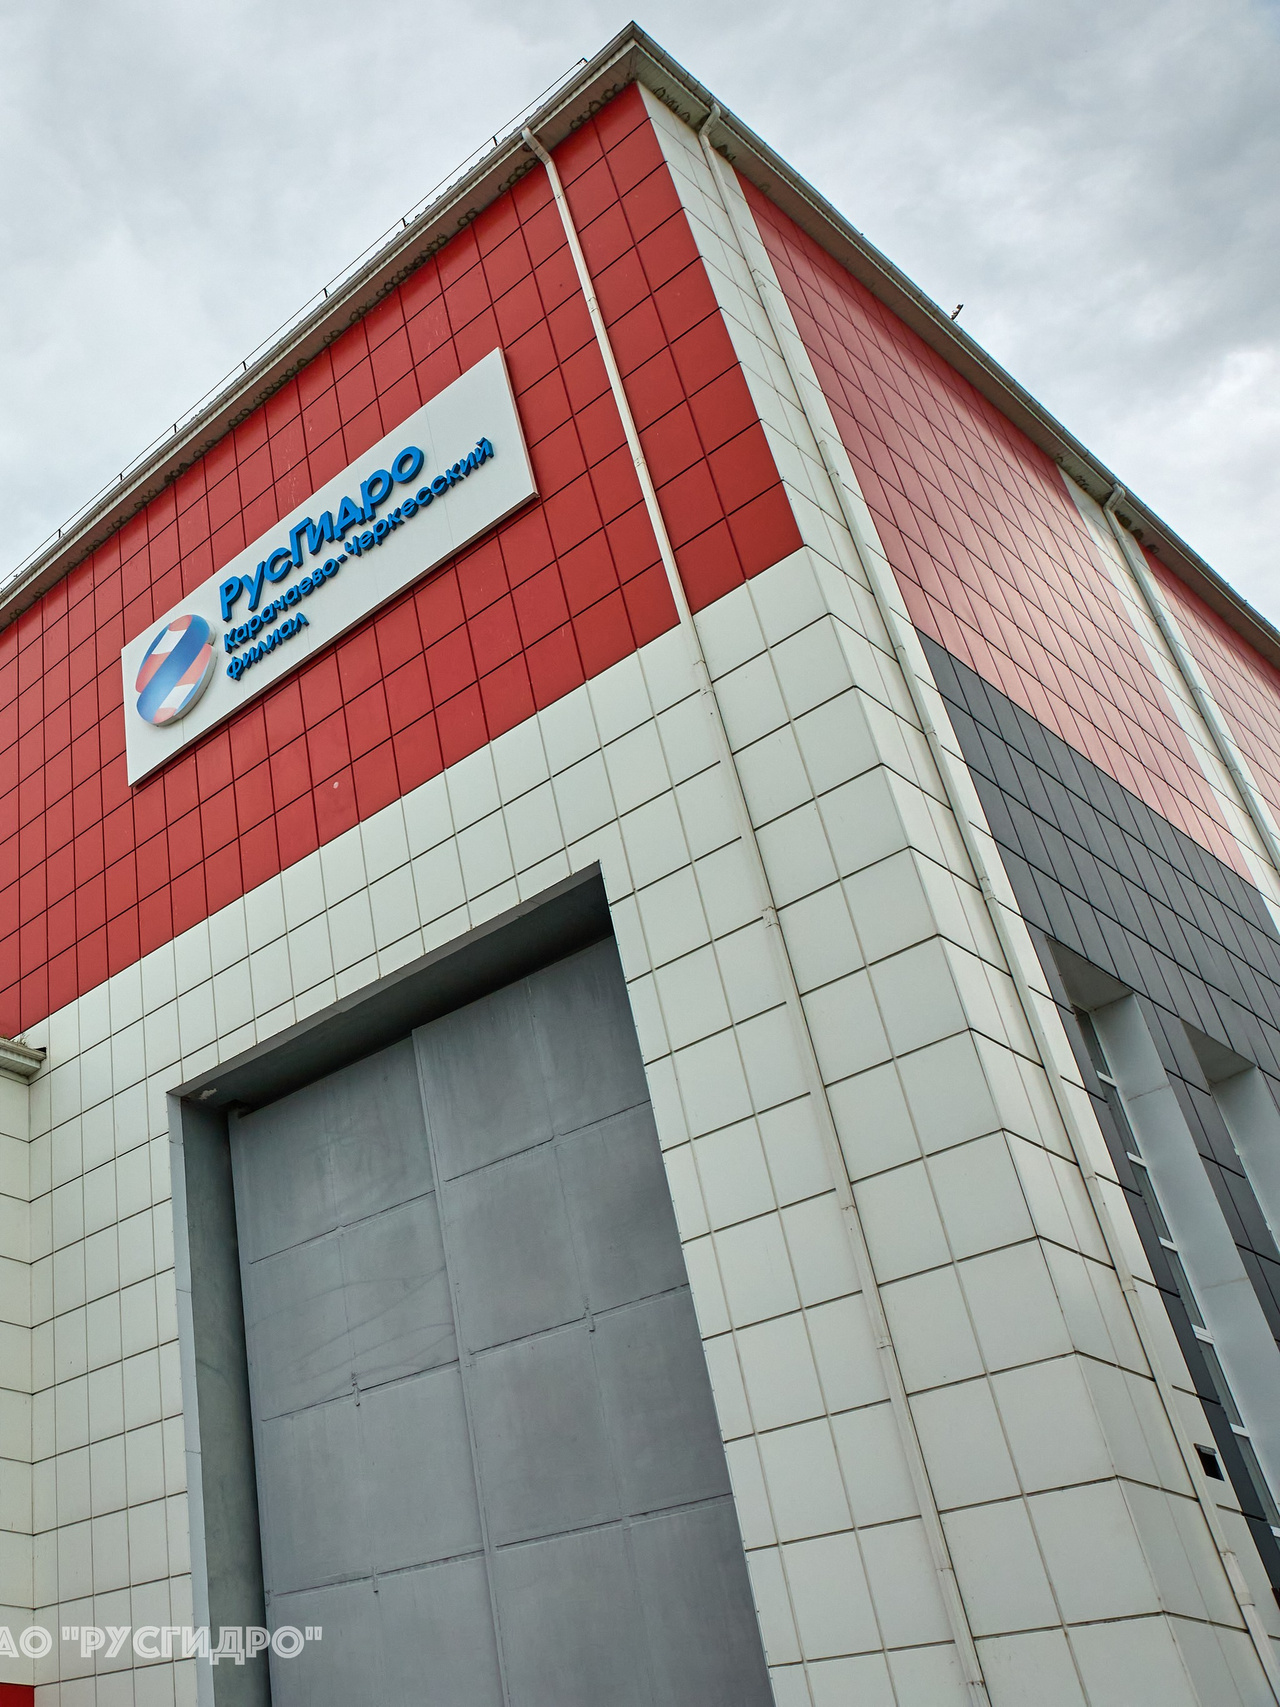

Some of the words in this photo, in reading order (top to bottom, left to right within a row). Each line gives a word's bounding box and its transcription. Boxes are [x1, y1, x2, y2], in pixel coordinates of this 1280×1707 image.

[219, 446, 424, 622] РусГидро
[224, 437, 495, 653] Карачаево-Черкесский
[226, 612, 310, 681] филиал
